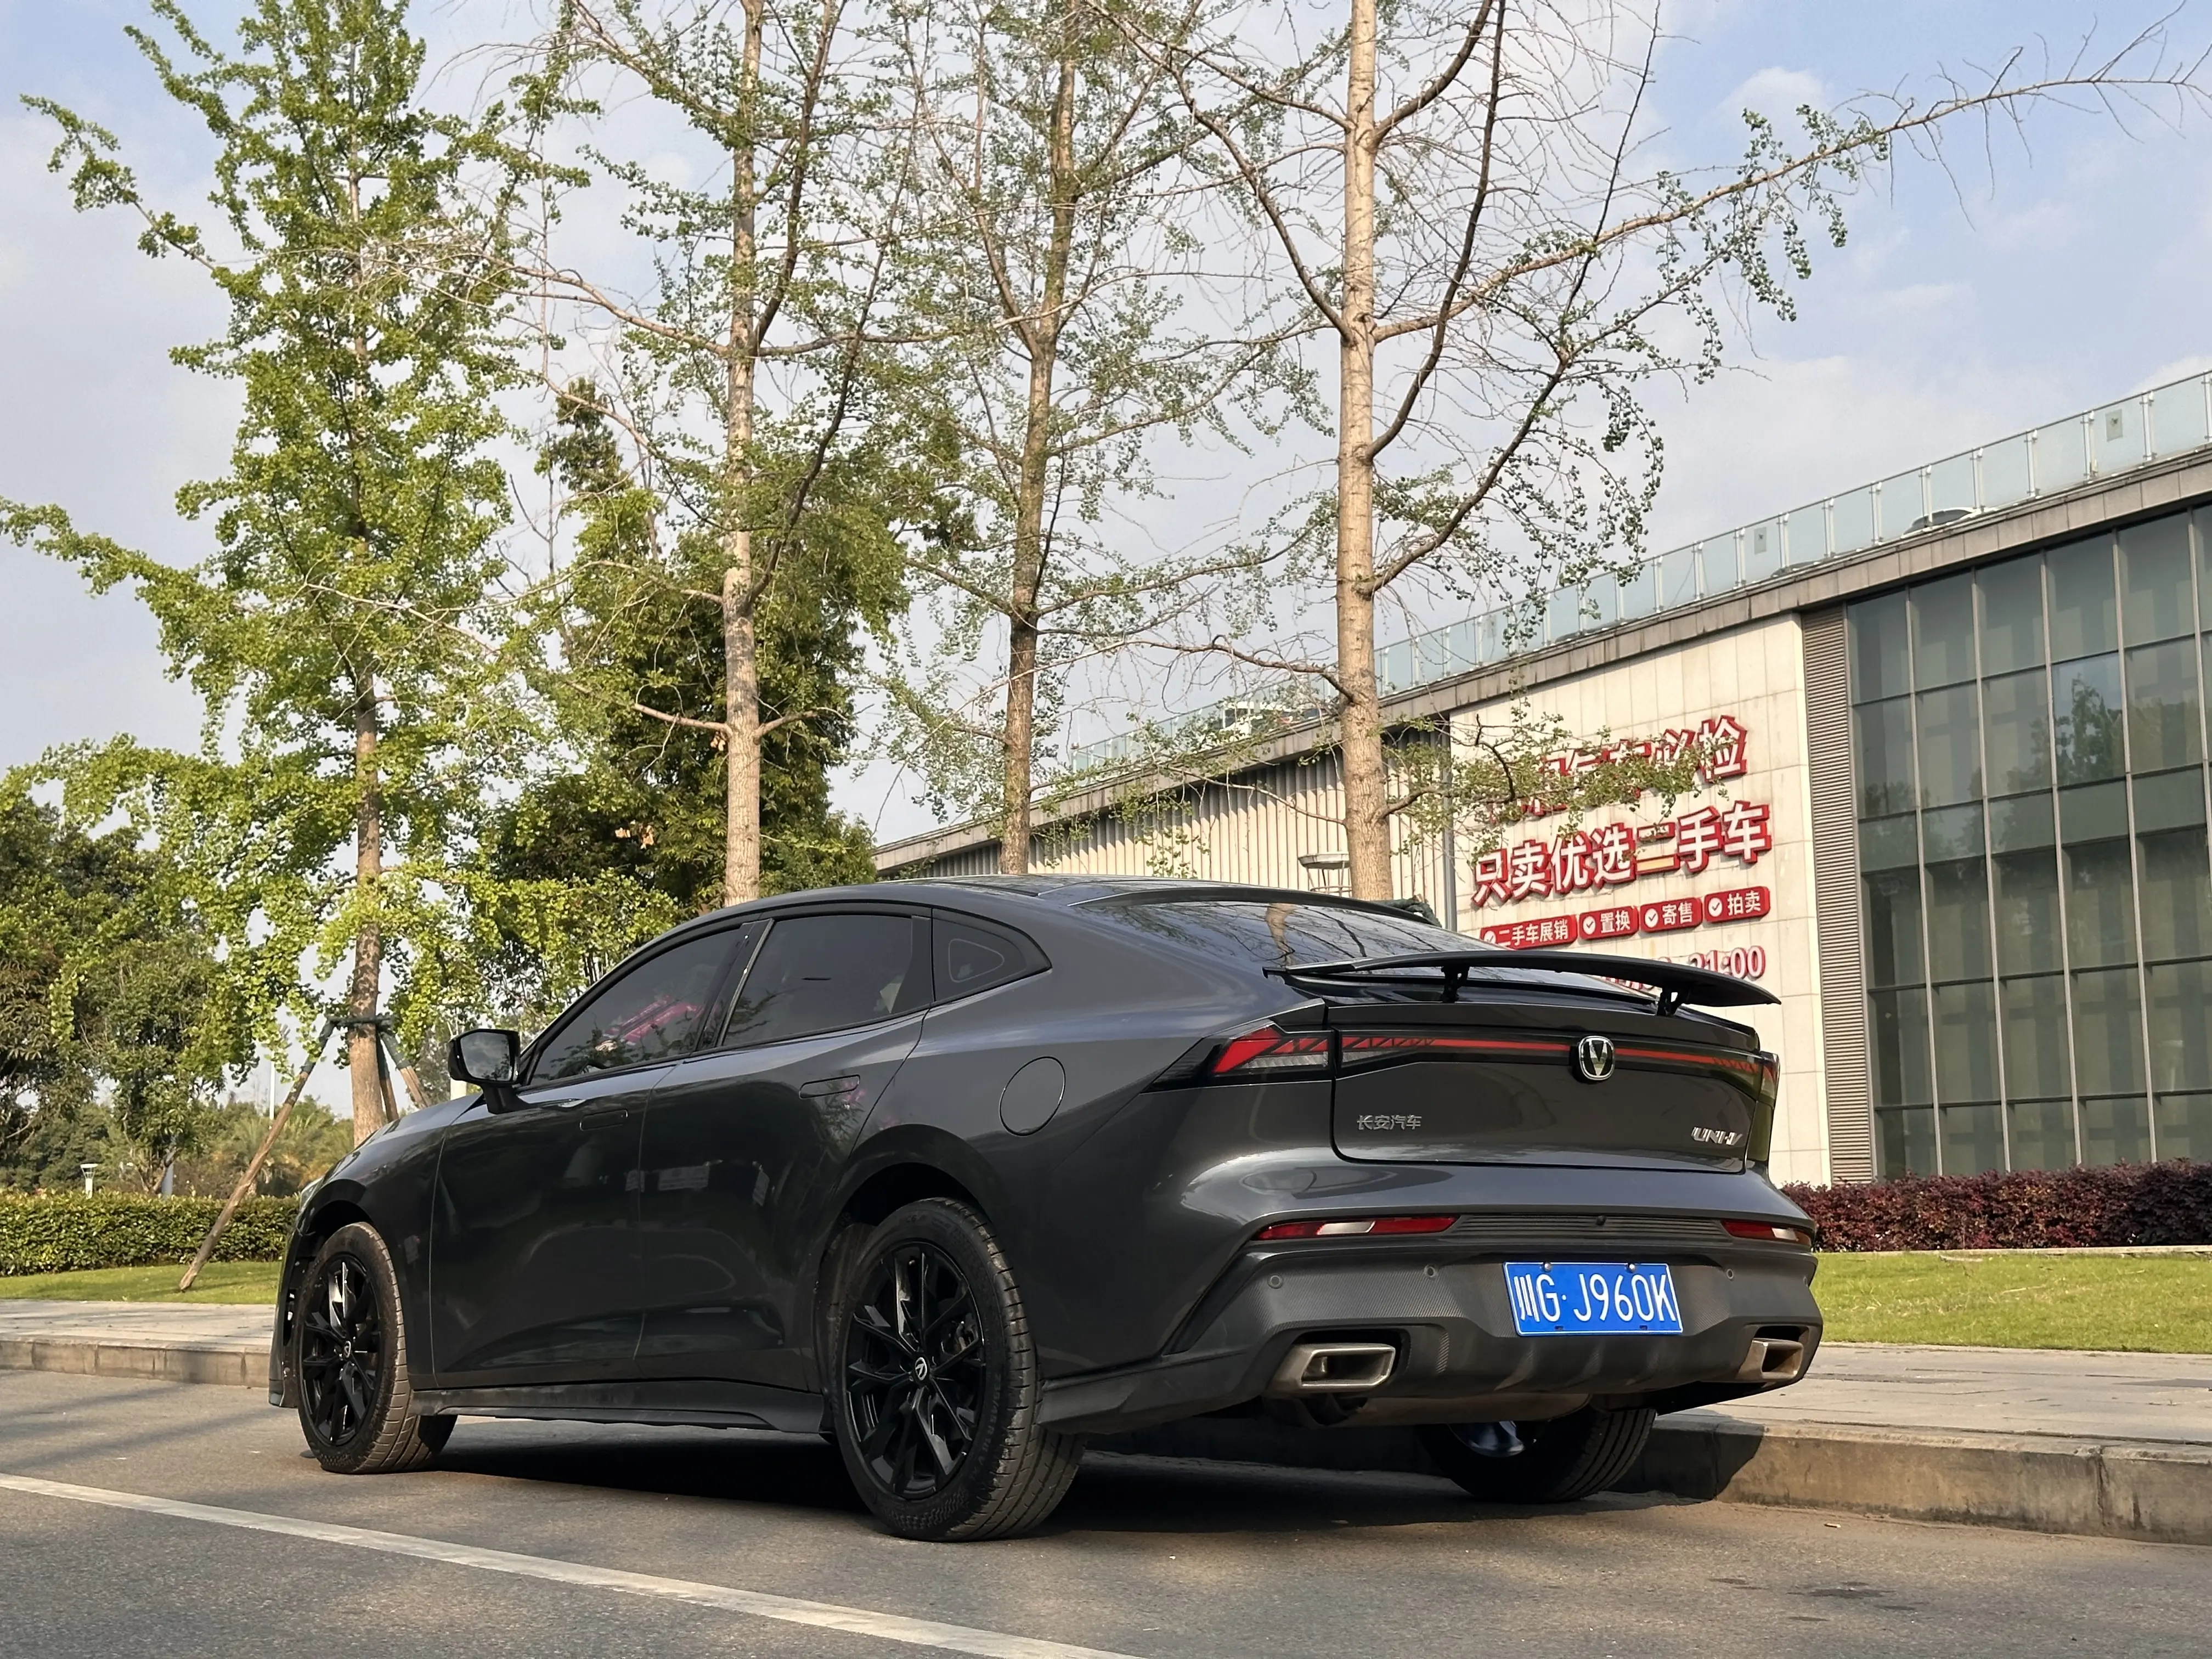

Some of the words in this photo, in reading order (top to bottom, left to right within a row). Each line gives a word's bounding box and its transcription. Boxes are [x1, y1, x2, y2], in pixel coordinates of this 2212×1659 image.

[1472, 800, 1771, 906] 只卖优选二手车
[1496, 920, 1568, 947] 二手车展销
[1600, 910, 1631, 933] 置换
[1662, 902, 1693, 925] 寄售
[1727, 891, 1760, 915] 拍卖
[1357, 1115, 1422, 1130] 长安汽车
